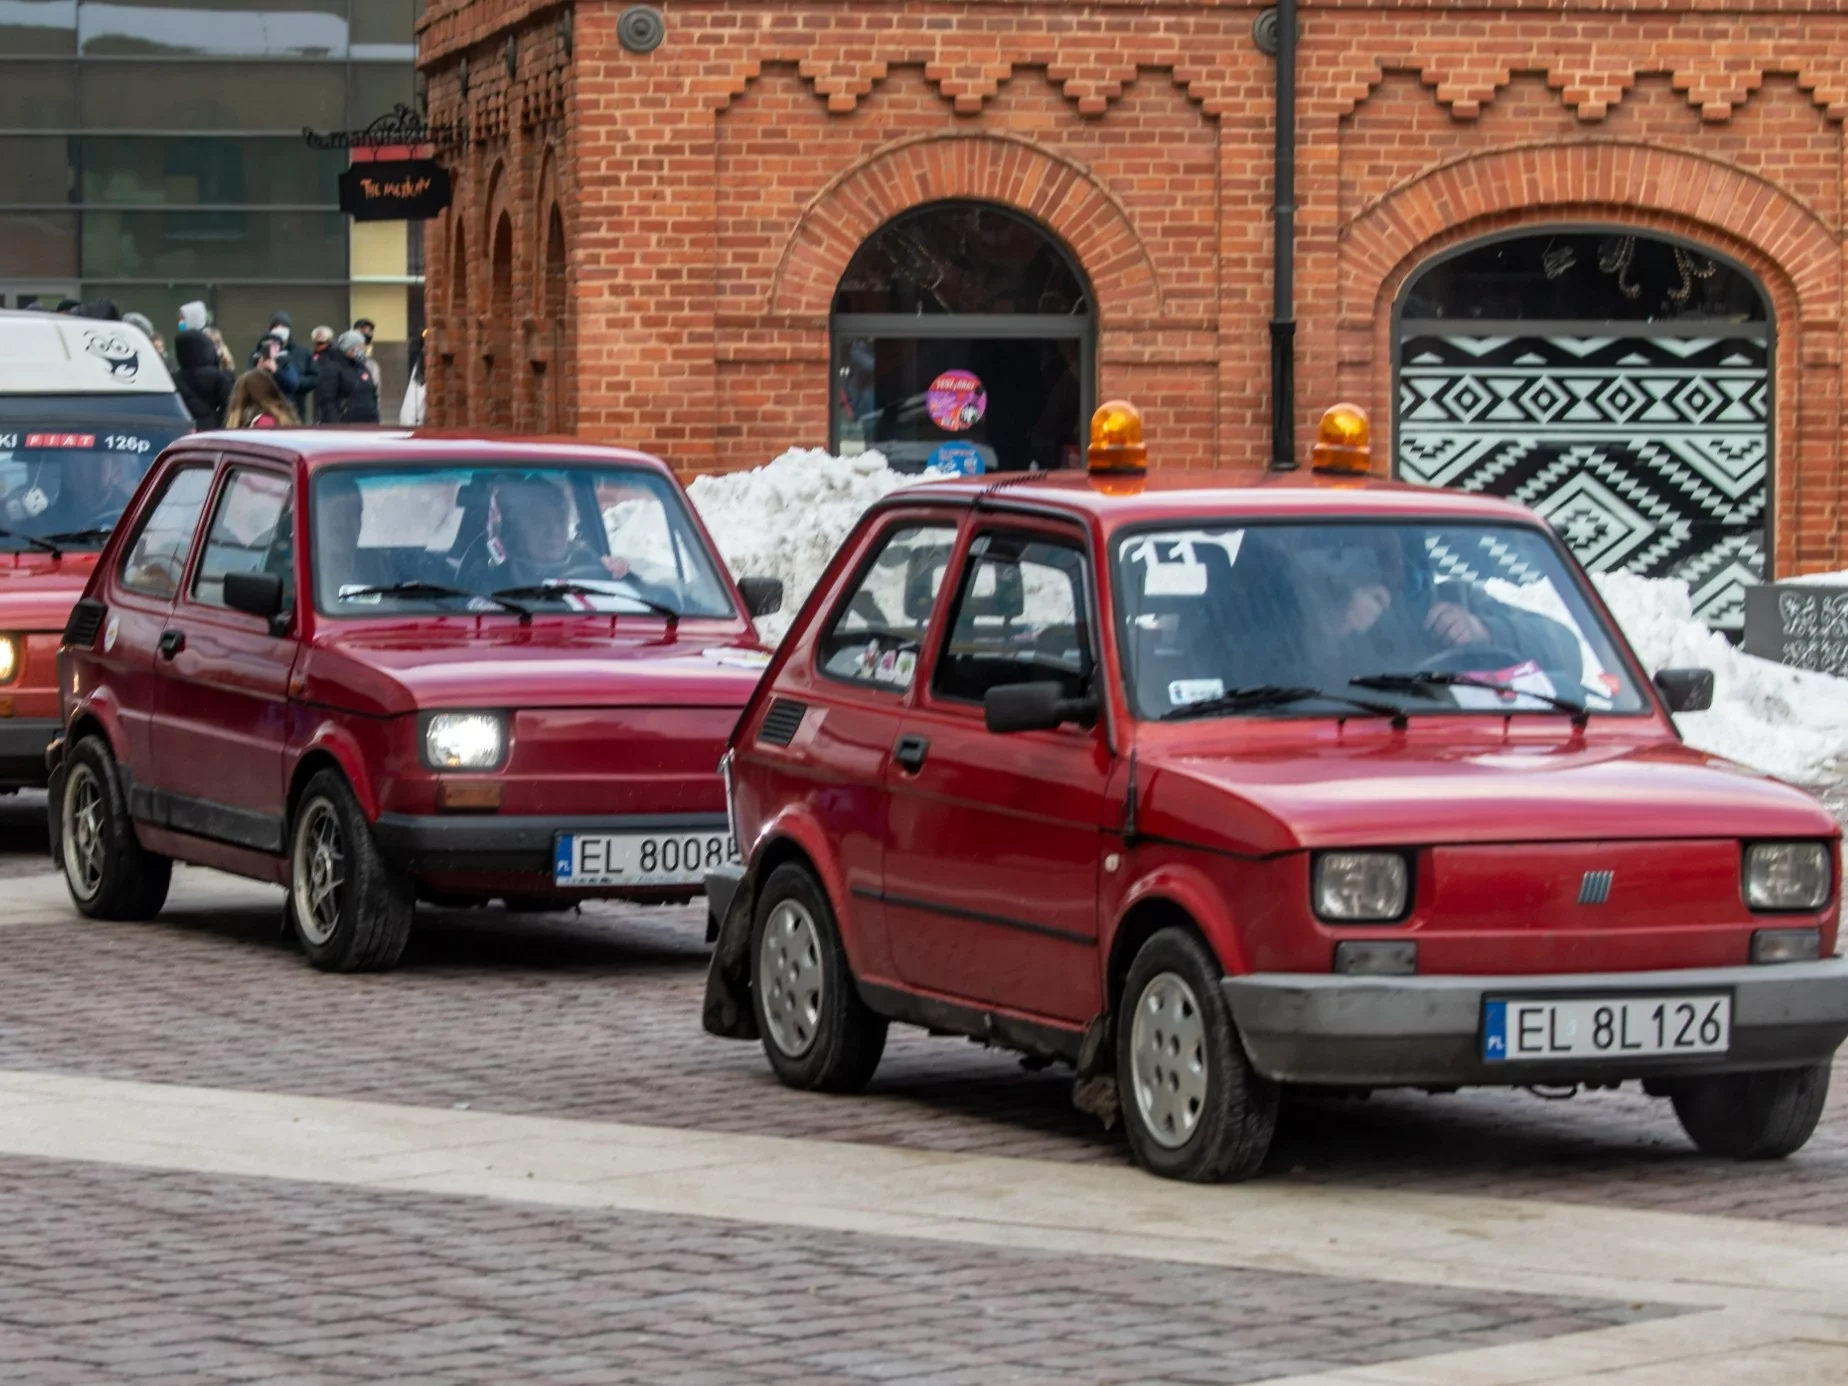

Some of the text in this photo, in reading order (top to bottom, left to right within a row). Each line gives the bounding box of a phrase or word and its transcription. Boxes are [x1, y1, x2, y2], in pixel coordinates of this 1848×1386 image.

[29, 433, 92, 448] FIAT
[104, 435, 151, 453] 126p
[580, 839, 624, 874] EL
[1518, 1001, 1721, 1052] EL 8L126
